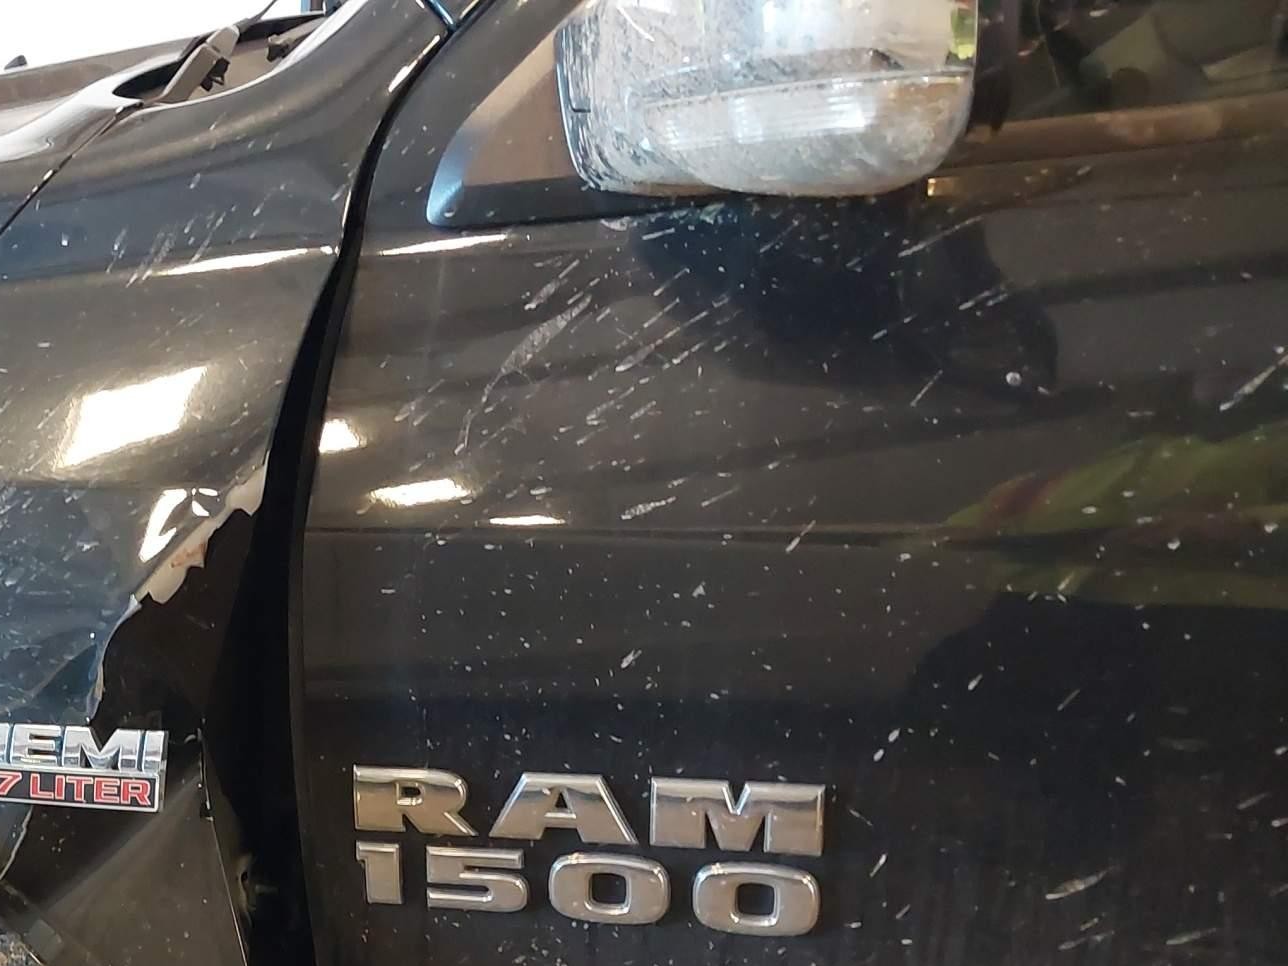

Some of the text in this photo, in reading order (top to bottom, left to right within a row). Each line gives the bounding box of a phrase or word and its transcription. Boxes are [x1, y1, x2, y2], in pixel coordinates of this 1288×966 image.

[30, 773, 152, 806] LITER
[353, 764, 826, 857] RAM
[355, 840, 822, 937] 1500
